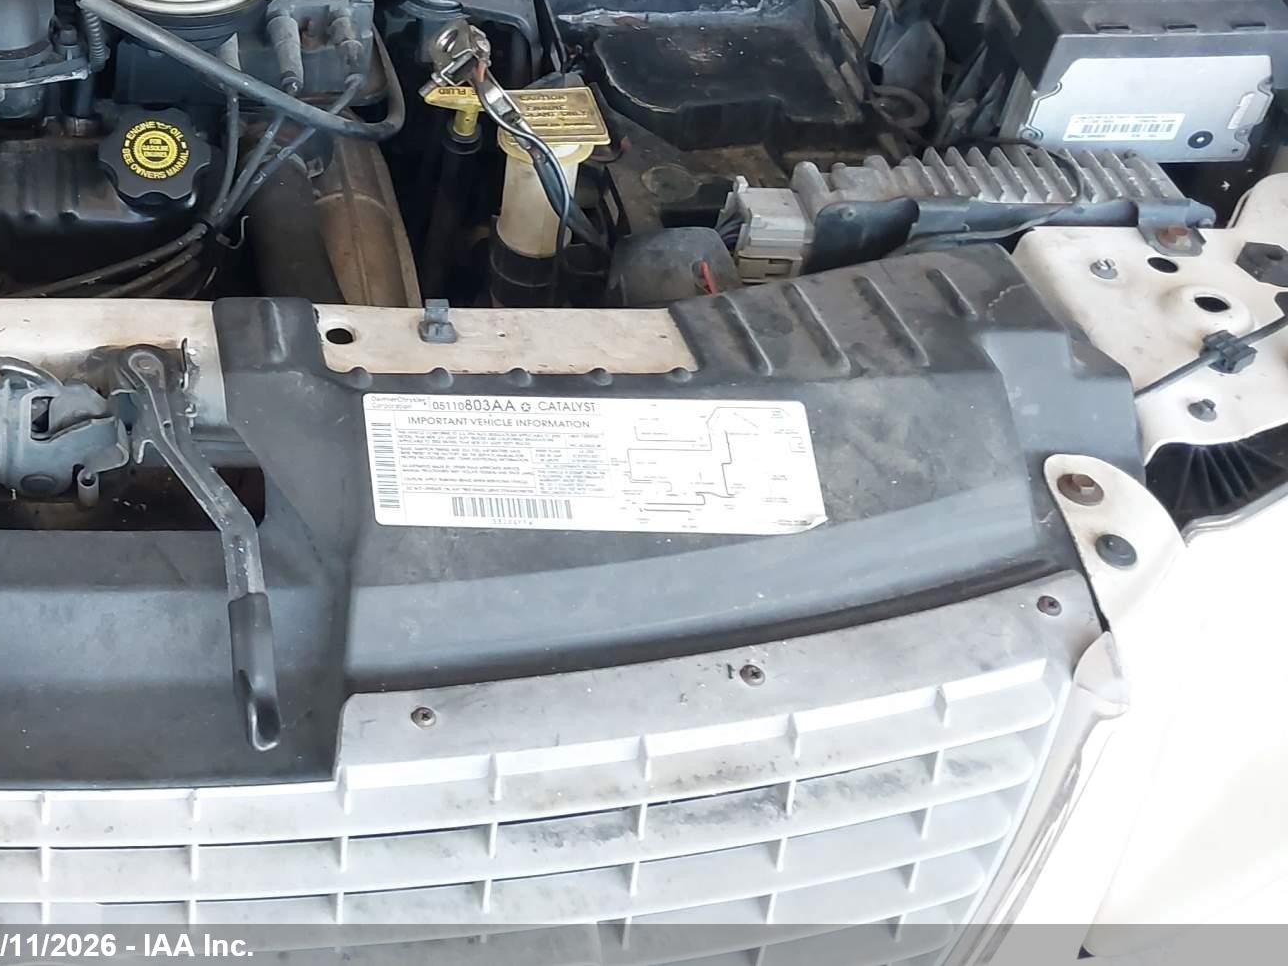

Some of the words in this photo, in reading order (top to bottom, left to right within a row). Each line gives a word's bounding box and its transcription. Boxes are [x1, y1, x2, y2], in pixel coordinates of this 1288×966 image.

[125, 120, 157, 140] ENGINE
[169, 127, 184, 142] OIL
[432, 399, 517, 412] 05110803AA
[537, 401, 596, 412] CATALYST
[408, 417, 468, 426] IMPORTANT
[470, 418, 513, 427] VEHICLE
[516, 419, 591, 428] INFORMATION
